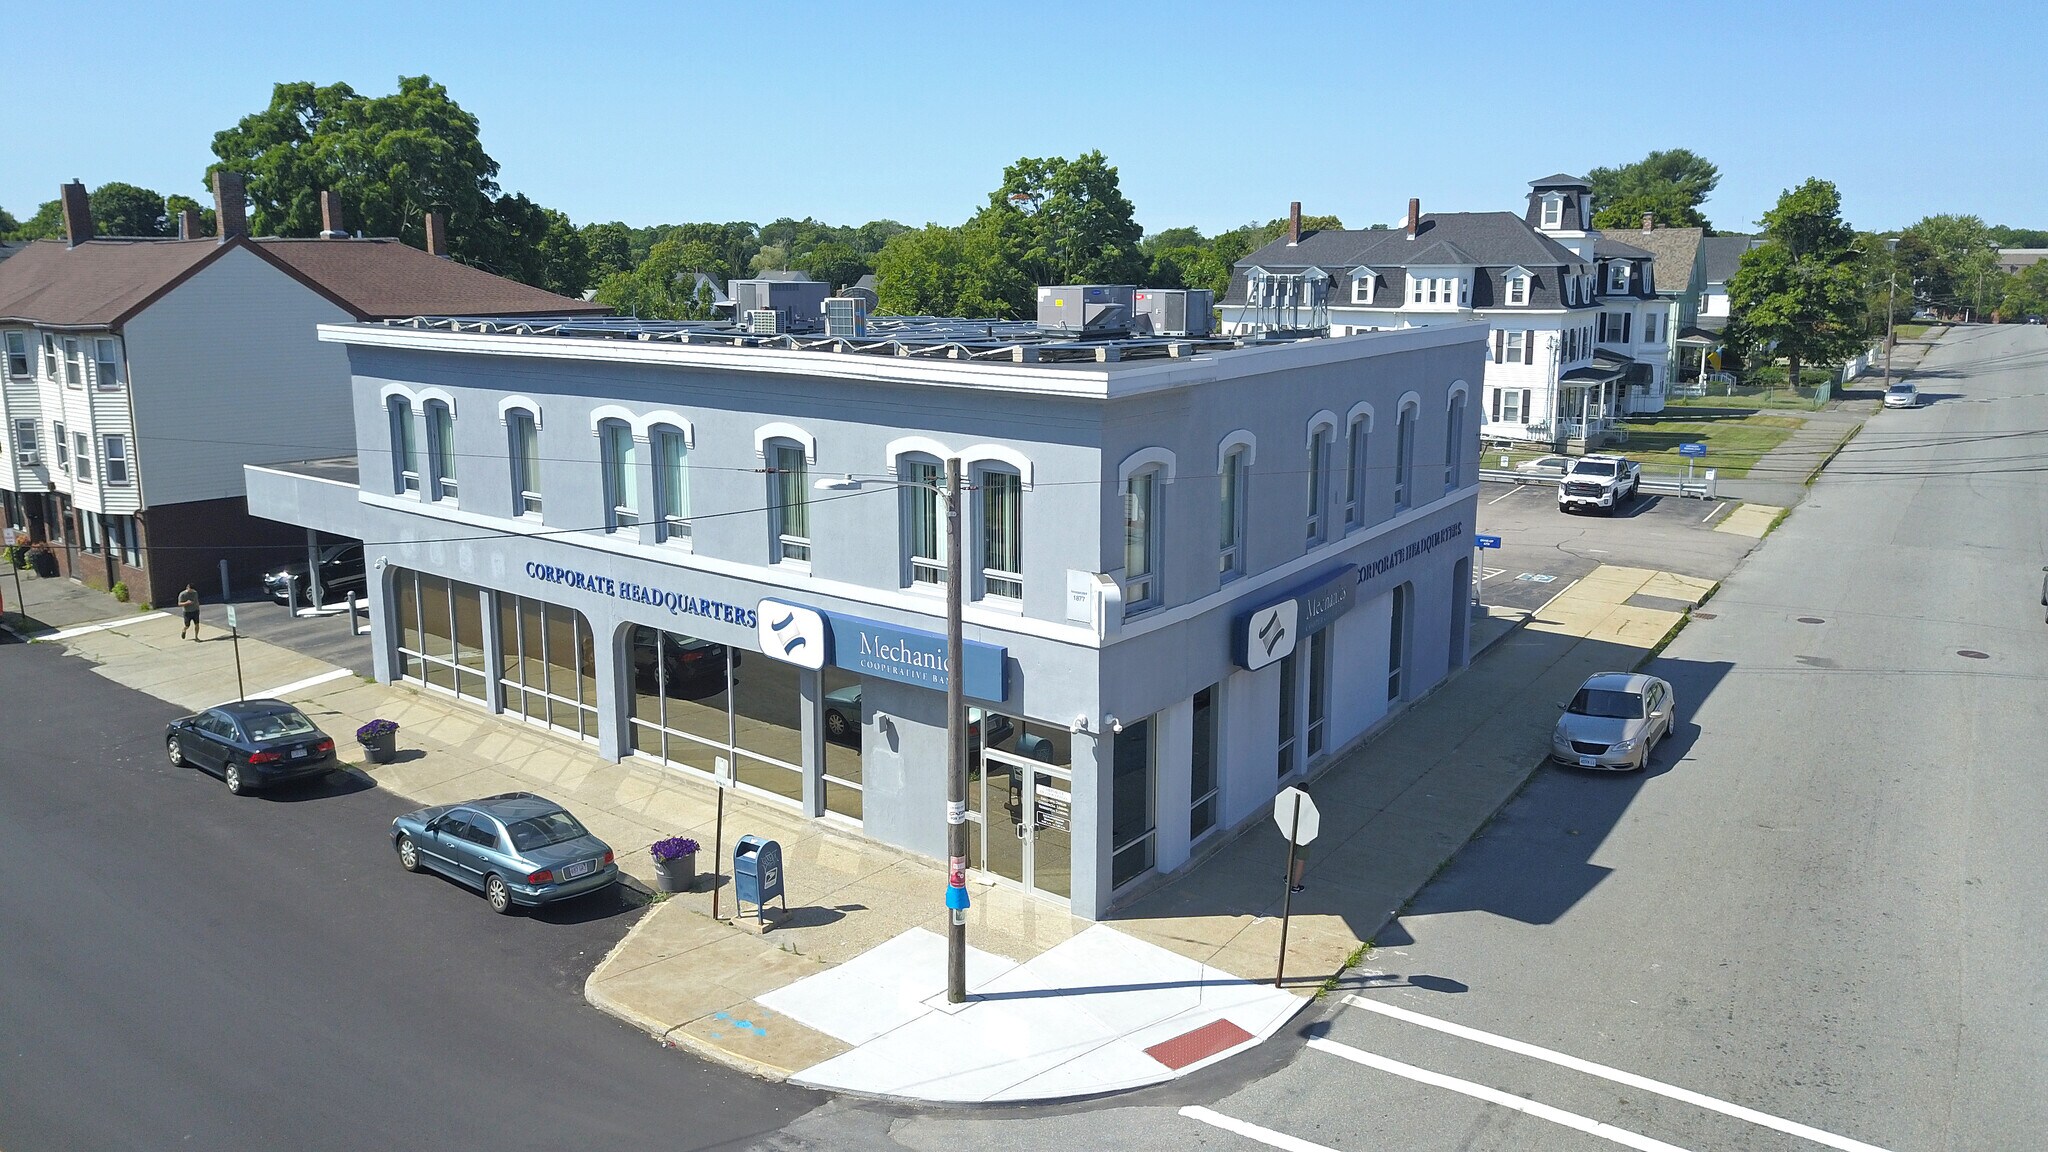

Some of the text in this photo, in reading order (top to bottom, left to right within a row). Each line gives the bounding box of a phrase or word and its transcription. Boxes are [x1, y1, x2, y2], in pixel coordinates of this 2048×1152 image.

[1406, 522, 1462, 561] HEADQUARTERS
[525, 561, 757, 629] CORPORATE HEADQUARTERS
[1073, 594, 1086, 602] 1877
[860, 631, 949, 672] Mechanic
[860, 659, 928, 680] COOPERATIVE
